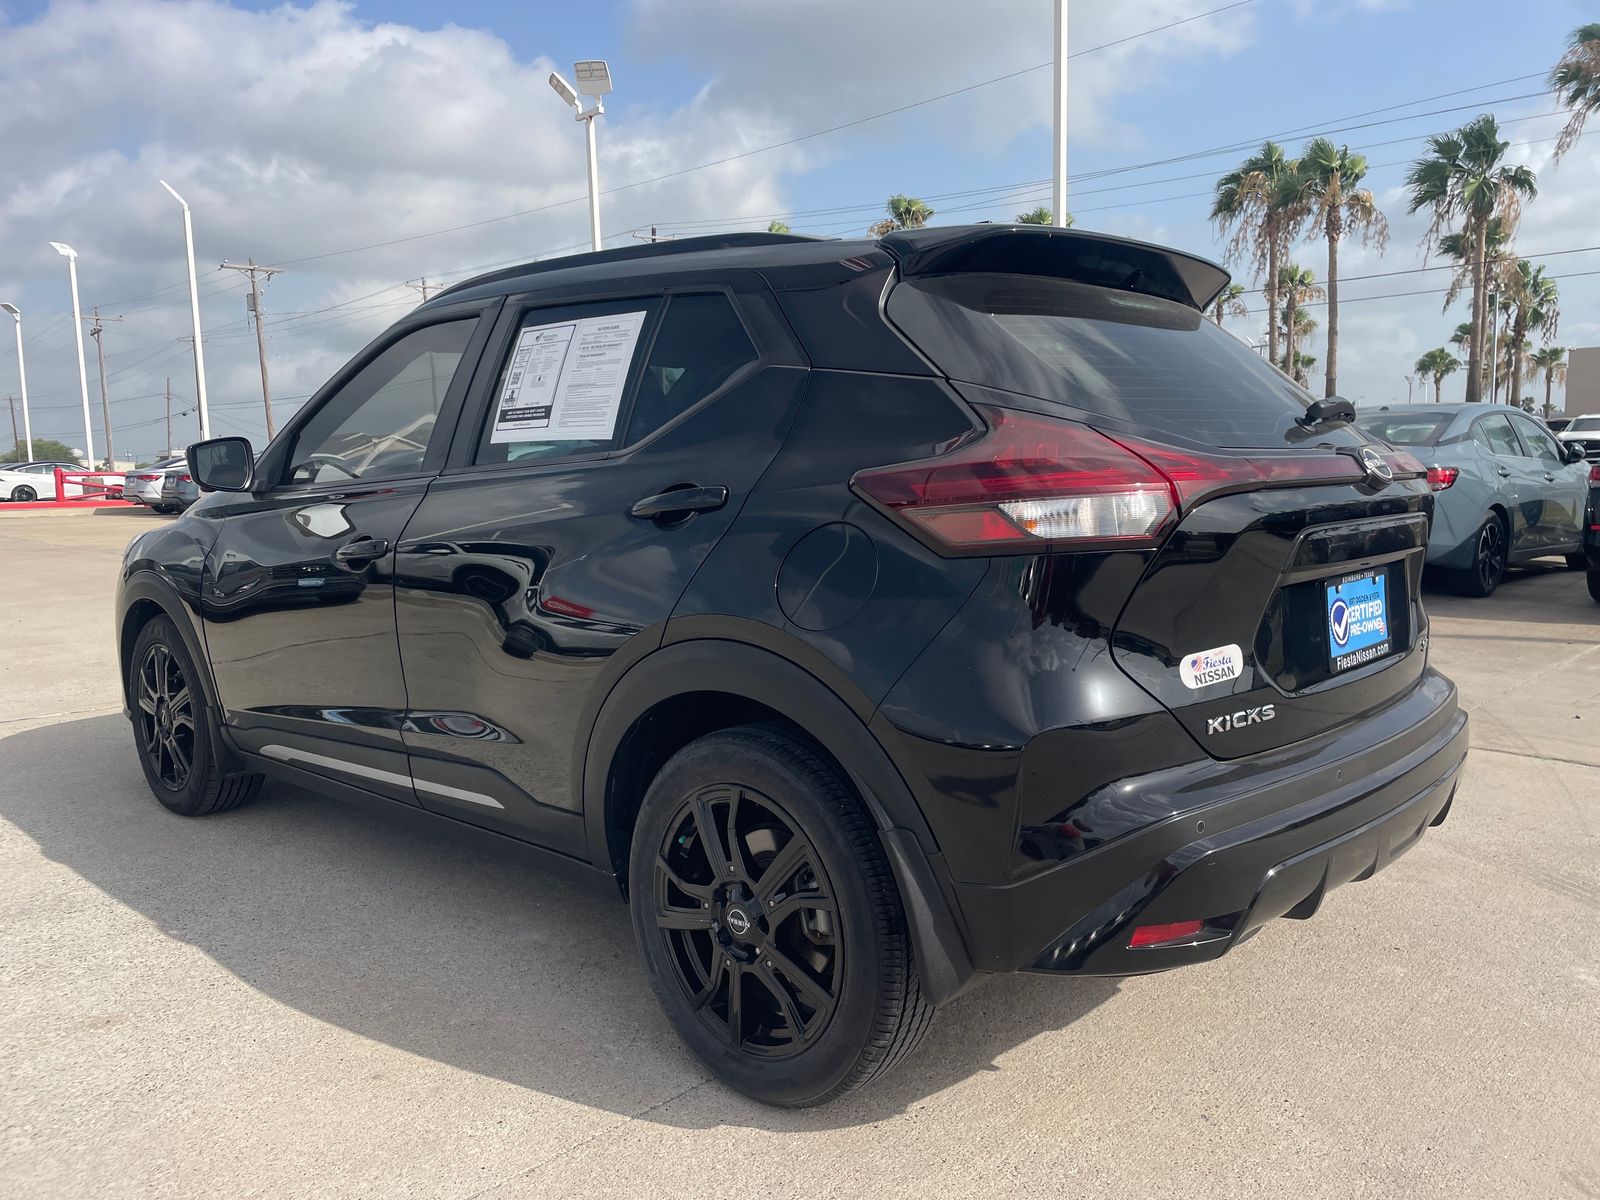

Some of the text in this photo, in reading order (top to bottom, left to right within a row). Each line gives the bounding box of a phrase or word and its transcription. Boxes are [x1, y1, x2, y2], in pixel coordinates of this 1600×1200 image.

[1348, 600, 1383, 623] CERTIFIED
[1202, 655, 1233, 671] Fiesta
[1336, 643, 1389, 671] FiestaNissan.com
[1194, 665, 1236, 686] NISSAN
[1206, 703, 1277, 735] KICKS
